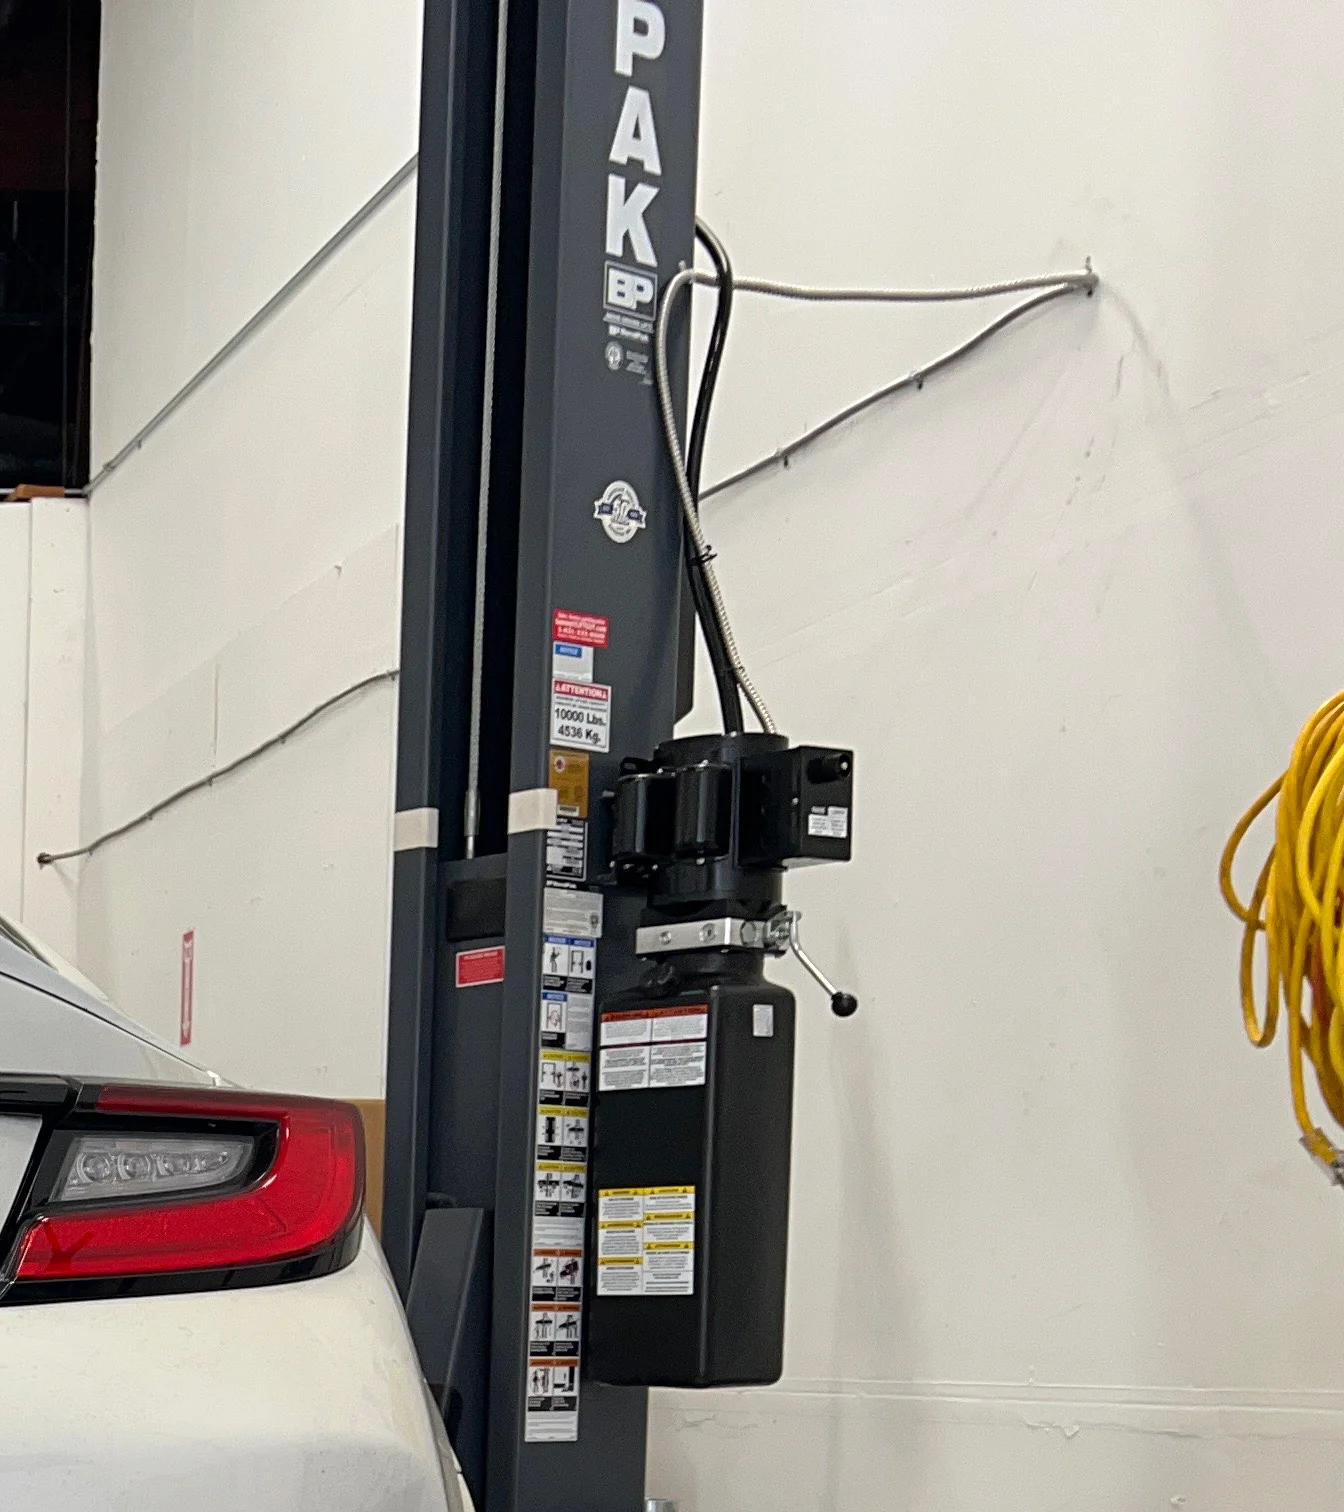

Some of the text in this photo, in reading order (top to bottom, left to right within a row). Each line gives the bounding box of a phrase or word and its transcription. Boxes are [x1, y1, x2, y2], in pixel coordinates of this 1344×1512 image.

[555, 708, 584, 723] 10000
[558, 724, 601, 744] 4536 Kg.
